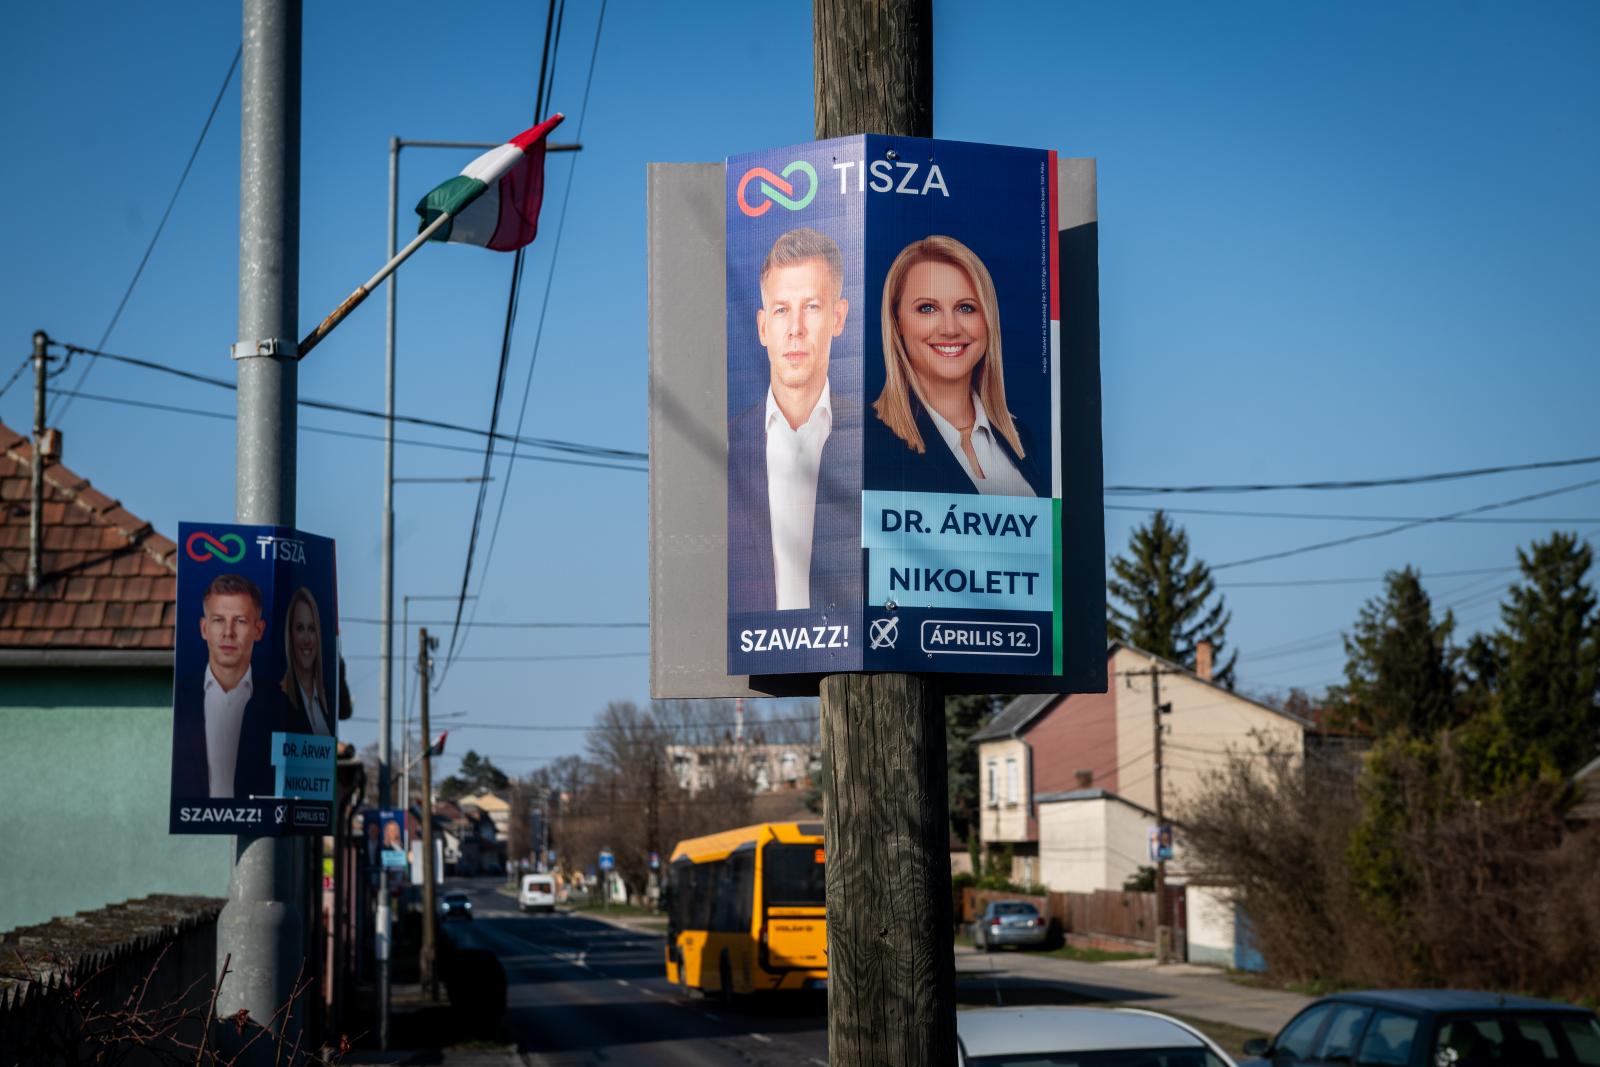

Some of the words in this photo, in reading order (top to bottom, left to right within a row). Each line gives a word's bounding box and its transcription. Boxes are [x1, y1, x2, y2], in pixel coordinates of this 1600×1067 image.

[833, 160, 950, 197] TISZA
[881, 508, 931, 534] DR.
[940, 504, 1038, 538] ÁRVAY
[256, 539, 306, 566] TISZA
[889, 567, 1040, 596] NIKOLETT
[740, 625, 849, 652] SZAVAZZ!
[930, 625, 1003, 647] ÁPRILIS
[1008, 631, 1031, 648] 12.
[282, 742, 299, 757] DR.
[301, 740, 331, 760] ÁRVAY
[284, 776, 330, 792] NIKOLETT
[180, 807, 262, 823] SZAVAZZ!
